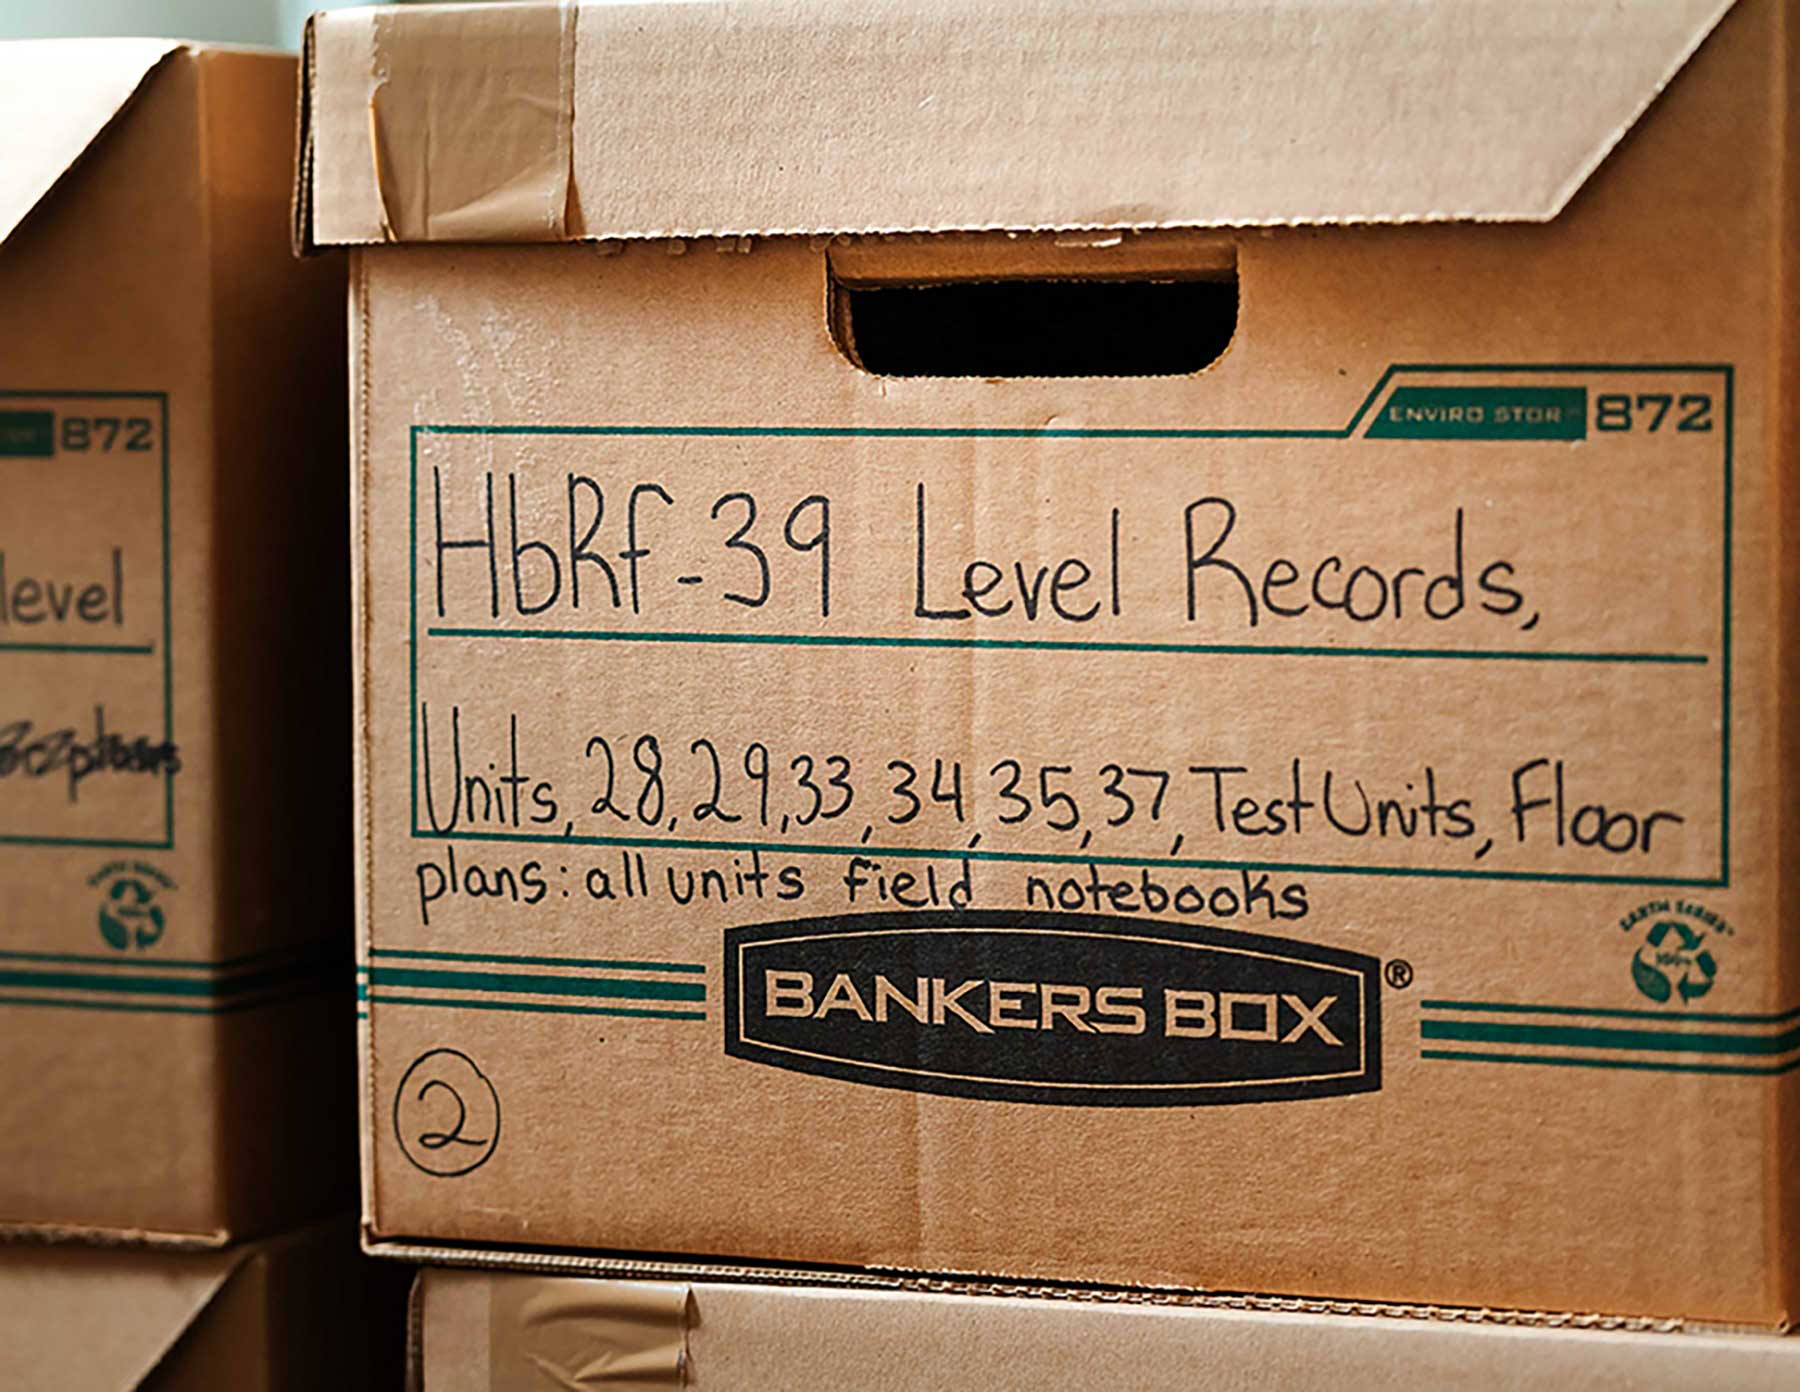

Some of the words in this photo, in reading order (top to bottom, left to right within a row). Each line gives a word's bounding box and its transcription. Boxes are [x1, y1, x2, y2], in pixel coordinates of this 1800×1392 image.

[60, 417, 153, 453] 872
[1389, 406, 1485, 424] ENVIRO
[1595, 394, 1714, 434] 872
[913, 482, 1120, 622] Level
[1184, 496, 1540, 630] Records,
[421, 701, 573, 837] Units,
[1511, 757, 1685, 854] Floor
[416, 845, 570, 925] plans:
[585, 851, 648, 898] all
[667, 849, 806, 905] units
[843, 857, 973, 910] field
[1026, 863, 1310, 920] notebooks
[763, 968, 1148, 1035] BANKERS
[1164, 987, 1343, 1047] BOX
[417, 1079, 488, 1149] 2
